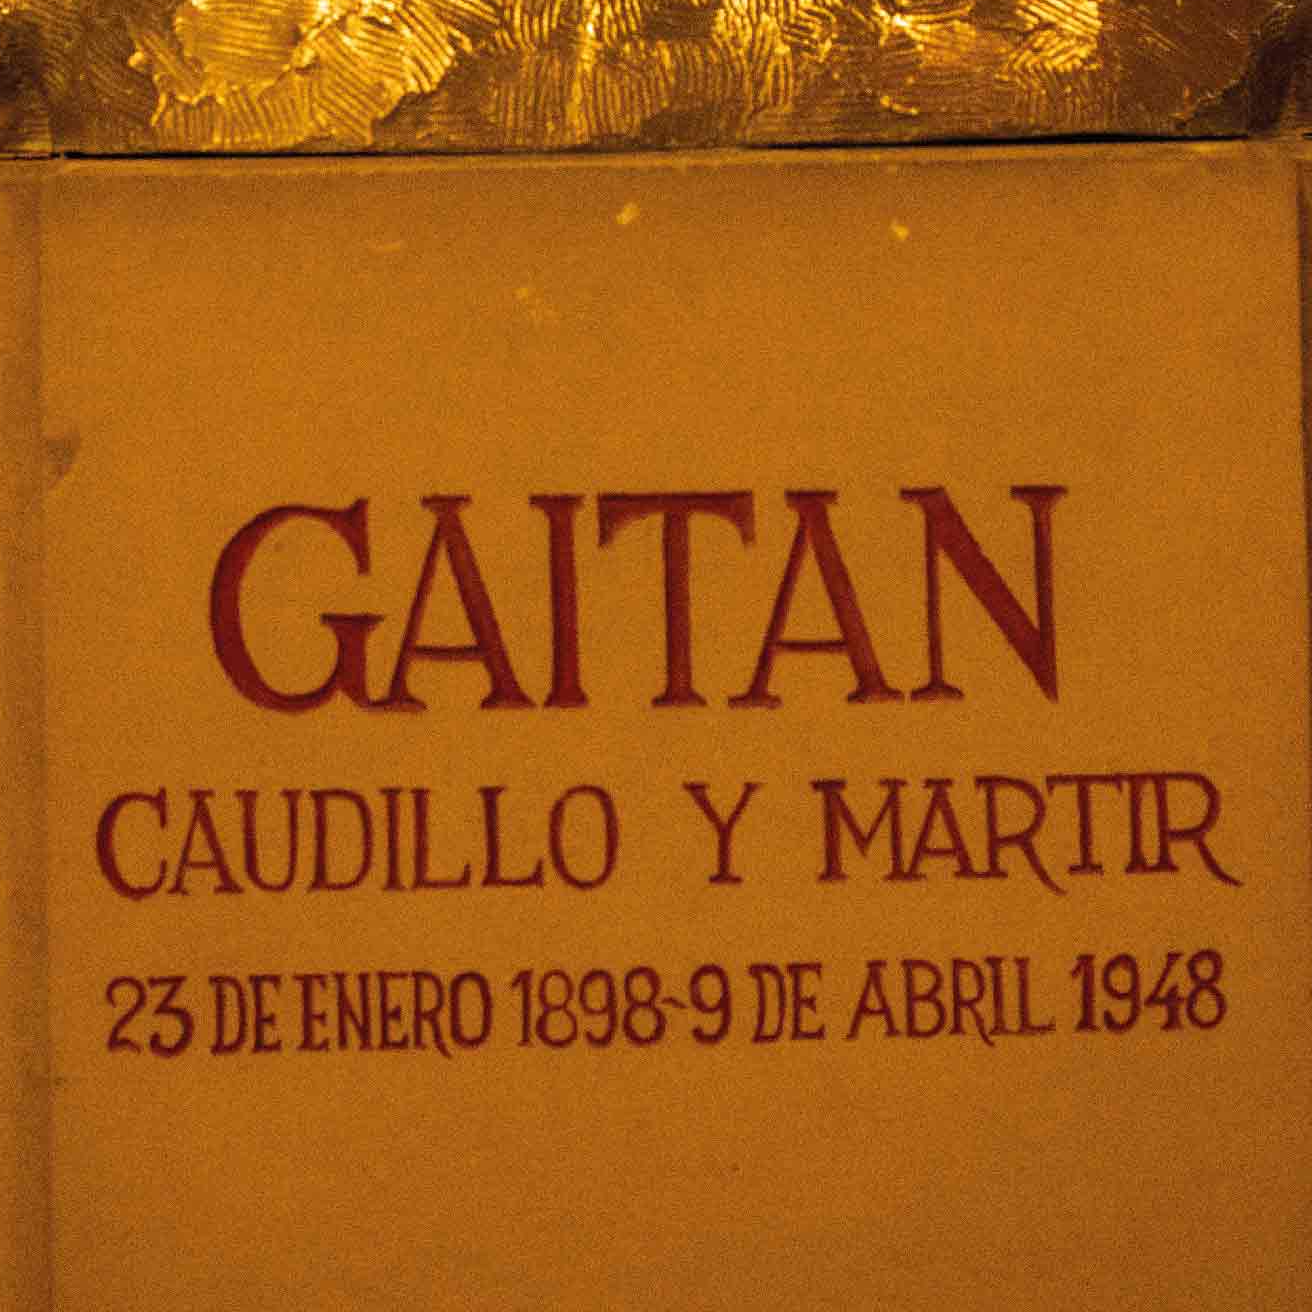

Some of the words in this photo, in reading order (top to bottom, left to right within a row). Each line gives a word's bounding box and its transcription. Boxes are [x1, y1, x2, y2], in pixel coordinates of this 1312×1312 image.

[205, 483, 1070, 717] GAITAN
[93, 782, 622, 904] CAUDILLO
[681, 779, 763, 887] Y
[807, 770, 1245, 897] MARTIR
[103, 973, 198, 1060] 23
[207, 972, 285, 1058] DE
[291, 969, 496, 1061] ENERO
[746, 960, 828, 1046] DE
[843, 953, 1059, 1048] ABRIL
[1068, 946, 1230, 1037] 1948
